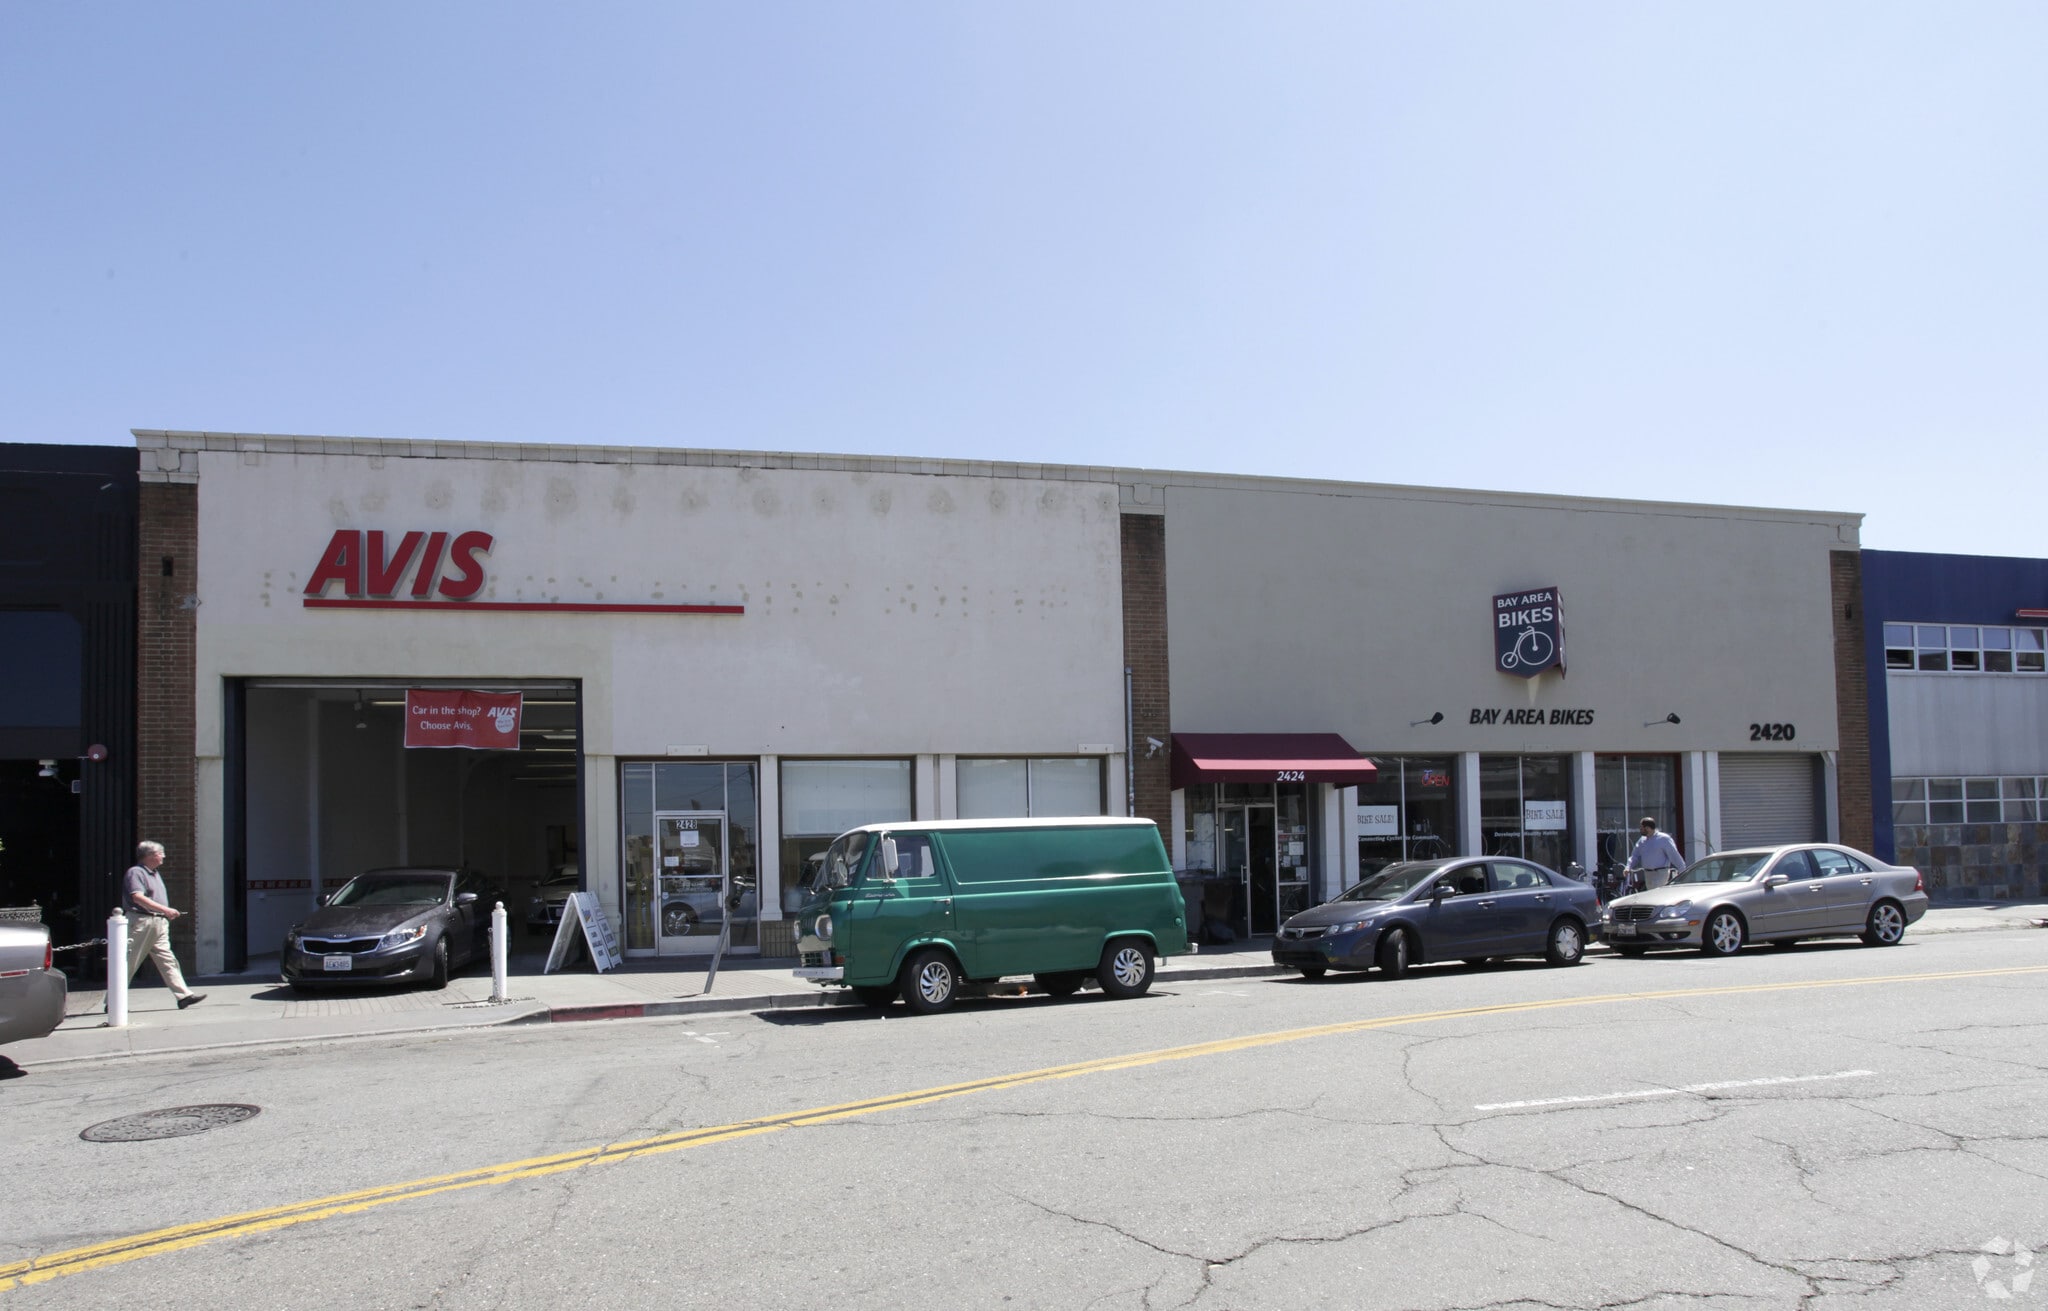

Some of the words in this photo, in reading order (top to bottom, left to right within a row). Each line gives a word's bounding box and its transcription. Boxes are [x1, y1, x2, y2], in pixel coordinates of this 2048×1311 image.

[303, 530, 494, 599] AVIS
[1497, 596, 1518, 608] BAY
[1521, 592, 1552, 605] AREA
[1499, 606, 1553, 628] BIKES
[412, 705, 427, 715] Car
[429, 705, 439, 715] in
[441, 706, 455, 715] the
[457, 706, 482, 718] shop?
[487, 706, 517, 718] AVIS
[1469, 708, 1501, 725] BAY
[1502, 708, 1545, 725] AREA
[1549, 709, 1595, 725] BIKES
[420, 720, 451, 730] Choose
[453, 721, 473, 731] Avis.
[1750, 723, 1796, 741] 2420
[1276, 770, 1305, 781] 2424
[1421, 774, 1450, 787] OPEN
[676, 820, 698, 829] 2428
[1357, 815, 1374, 825] BIKE
